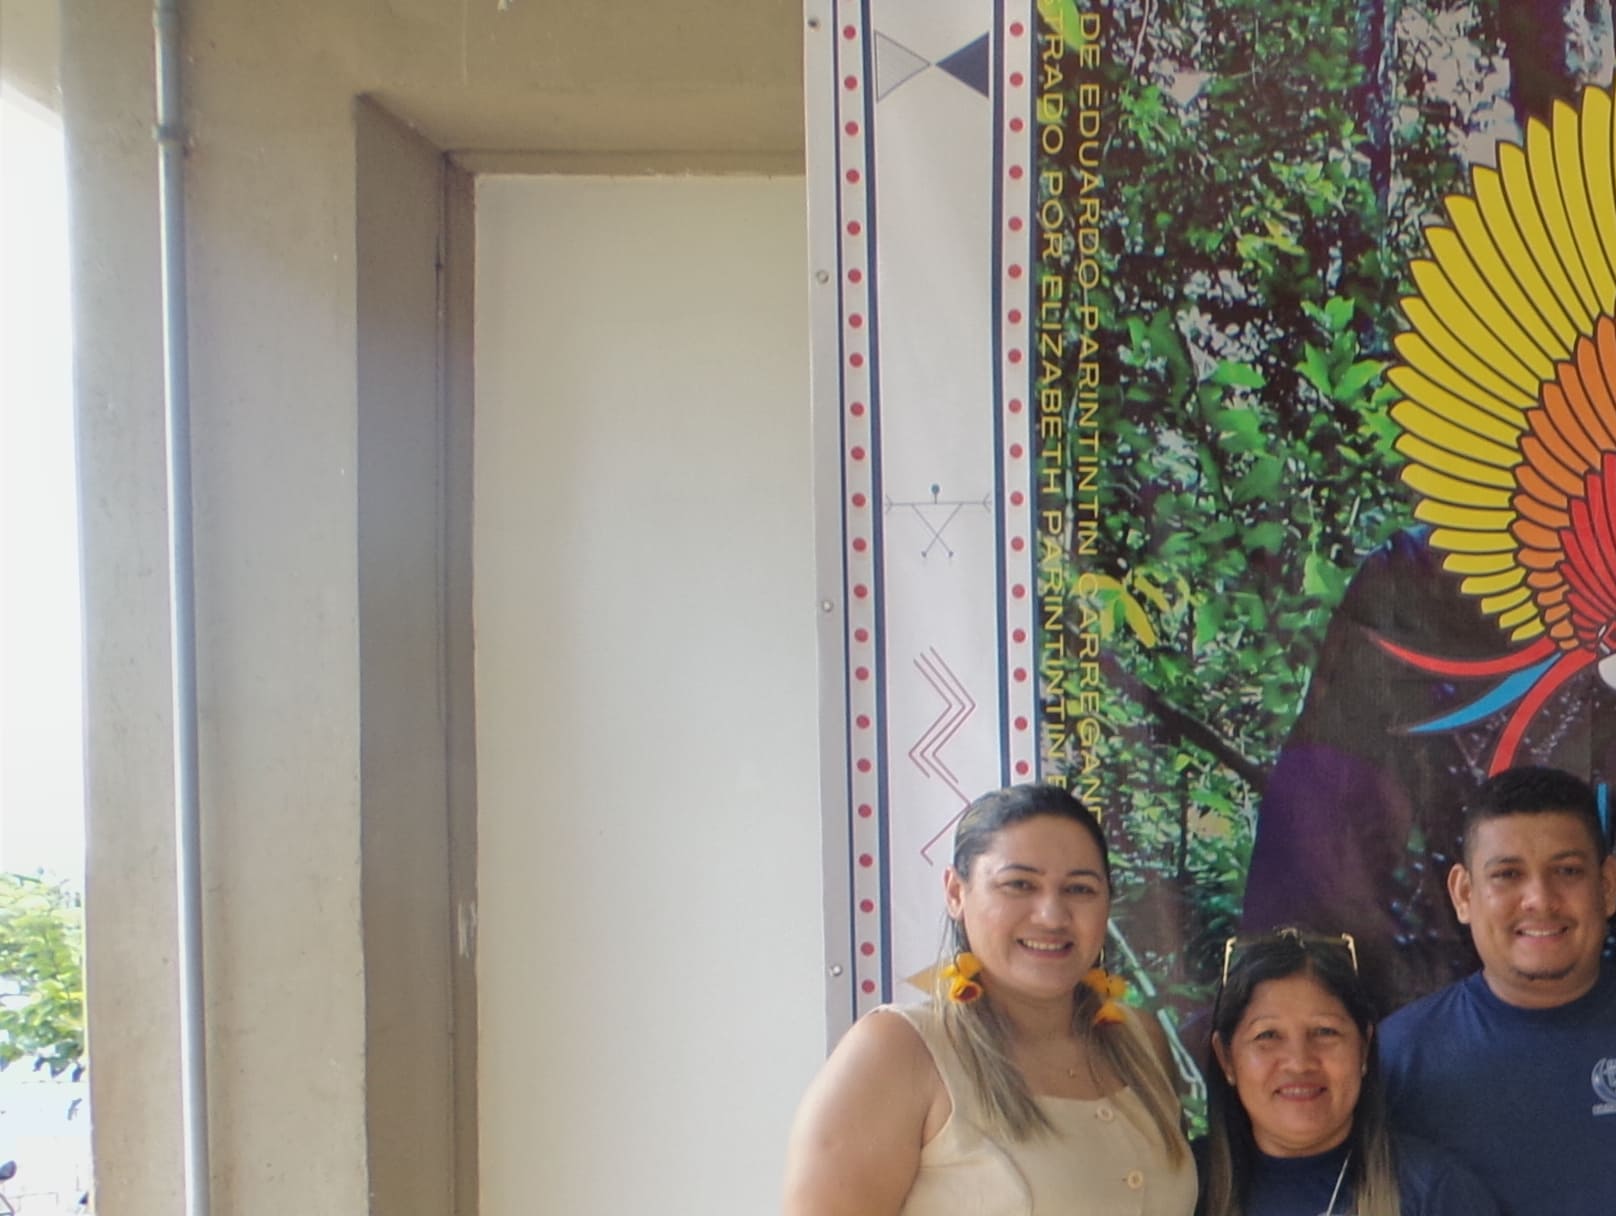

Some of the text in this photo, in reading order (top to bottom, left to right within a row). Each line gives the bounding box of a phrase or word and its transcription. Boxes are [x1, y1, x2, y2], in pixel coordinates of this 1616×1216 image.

[1079, 12, 1101, 68] DE
[1042, 170, 1064, 260] POR
[1078, 83, 1101, 289] EDUARDO
[1041, 275, 1063, 493] ELIZABETH
[1078, 305, 1100, 556] PARINTINTIN
[1042, 510, 1066, 759] PARINTINTIN
